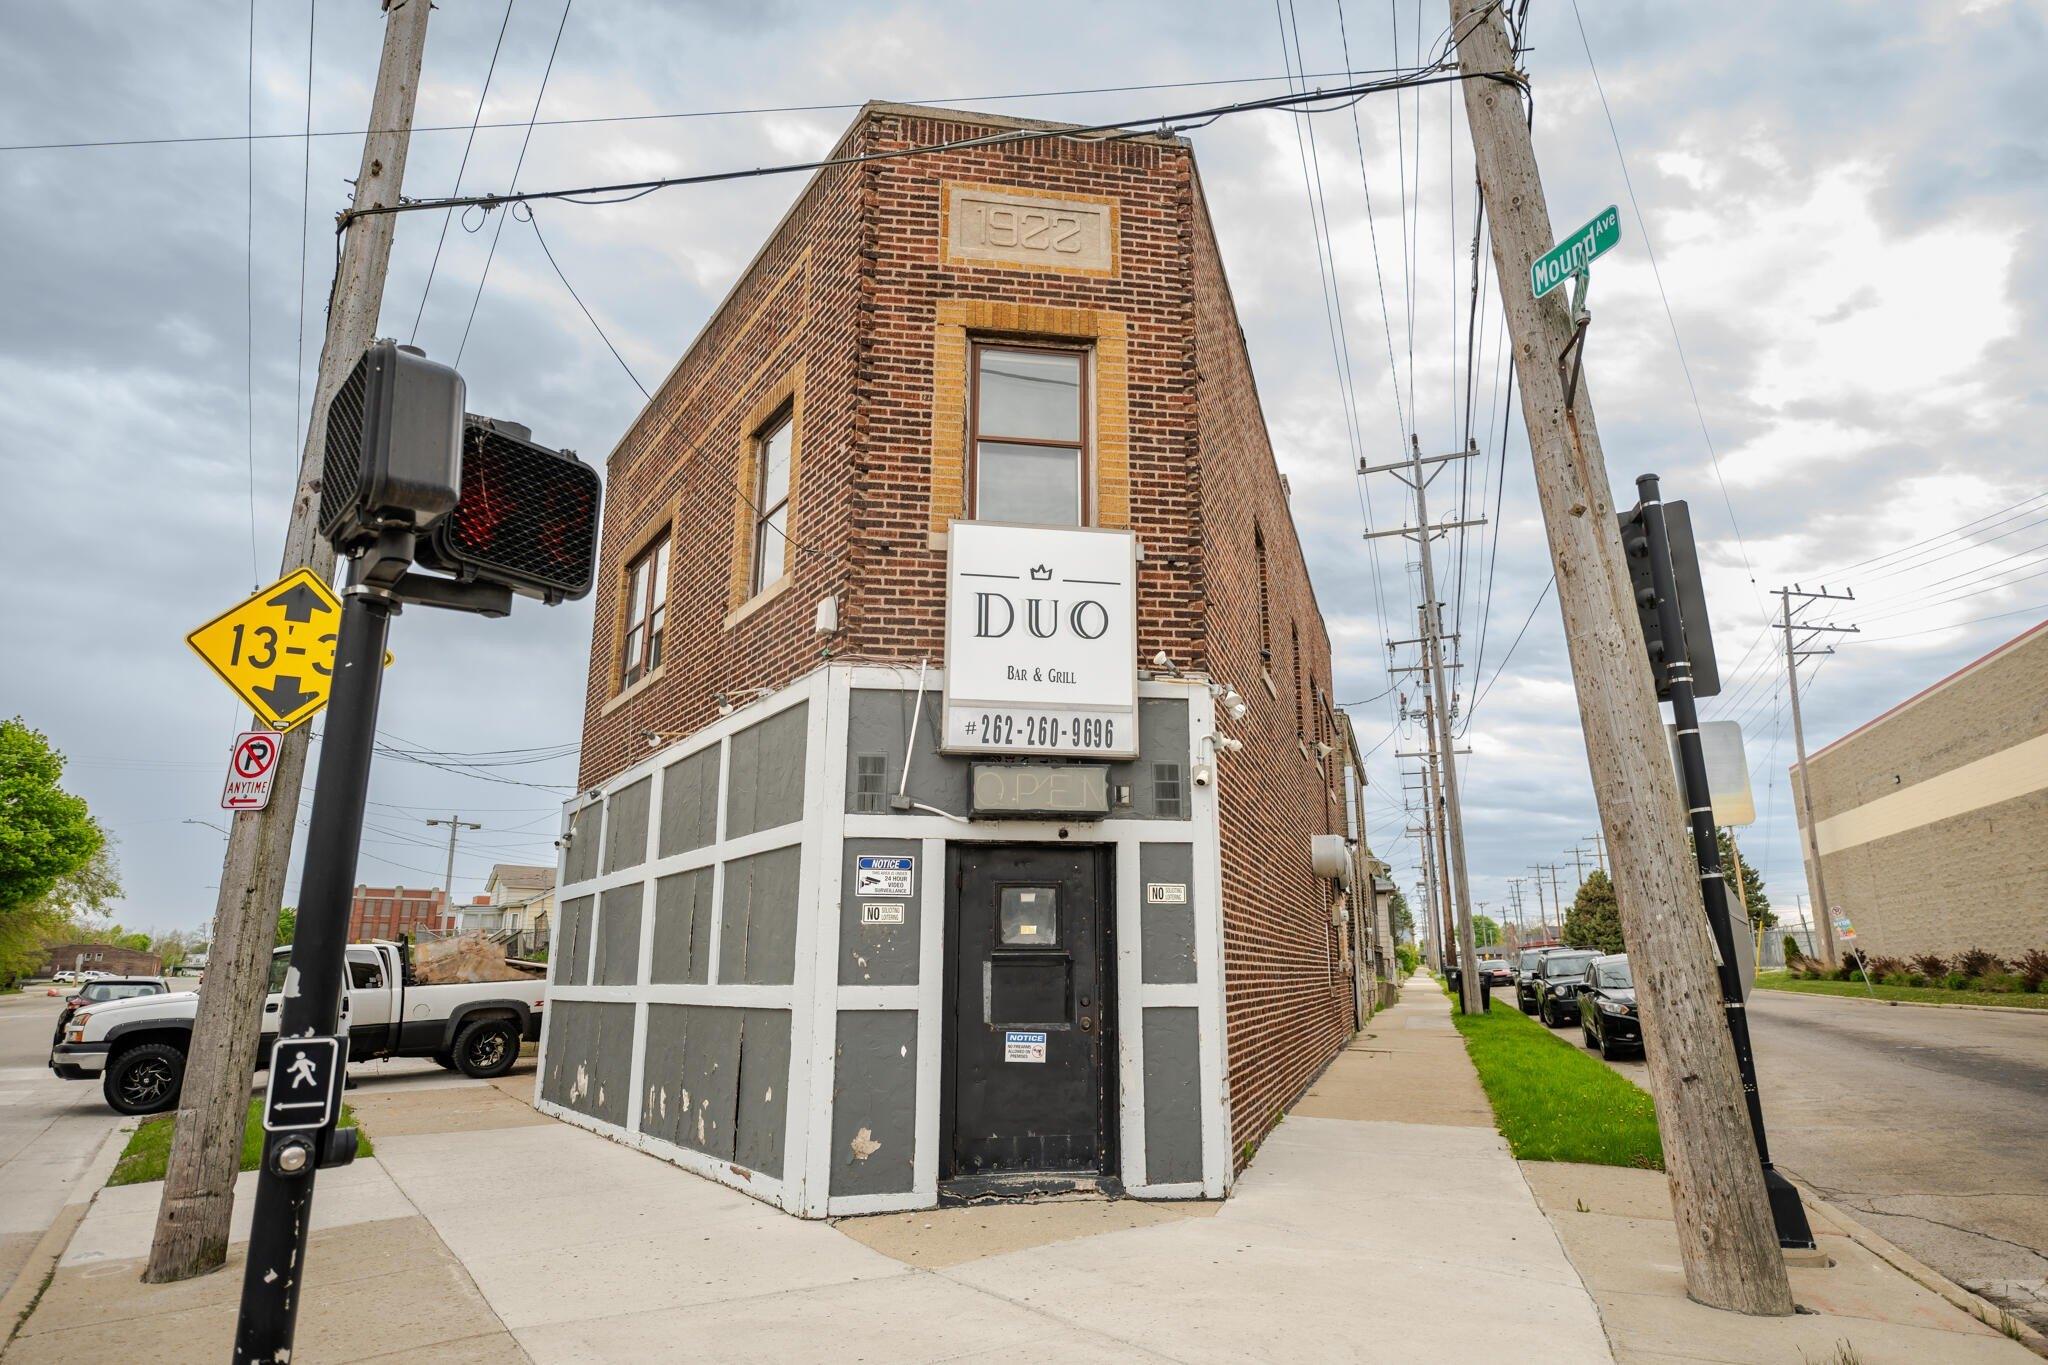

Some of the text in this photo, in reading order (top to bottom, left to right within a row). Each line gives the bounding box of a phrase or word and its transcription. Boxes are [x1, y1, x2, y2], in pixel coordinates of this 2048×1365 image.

[977, 206, 1081, 253] 1922
[1535, 213, 1616, 292] Mound Ave
[973, 592, 1109, 640] DUO
[1033, 668, 1043, 682] &
[227, 781, 268, 795] ANYTIME
[974, 771, 1107, 808] OPEN
[871, 859, 900, 869] NOTICE
[1152, 887, 1164, 900] NO
[867, 907, 880, 920] NO
[1010, 1034, 1043, 1042] NOTICE
